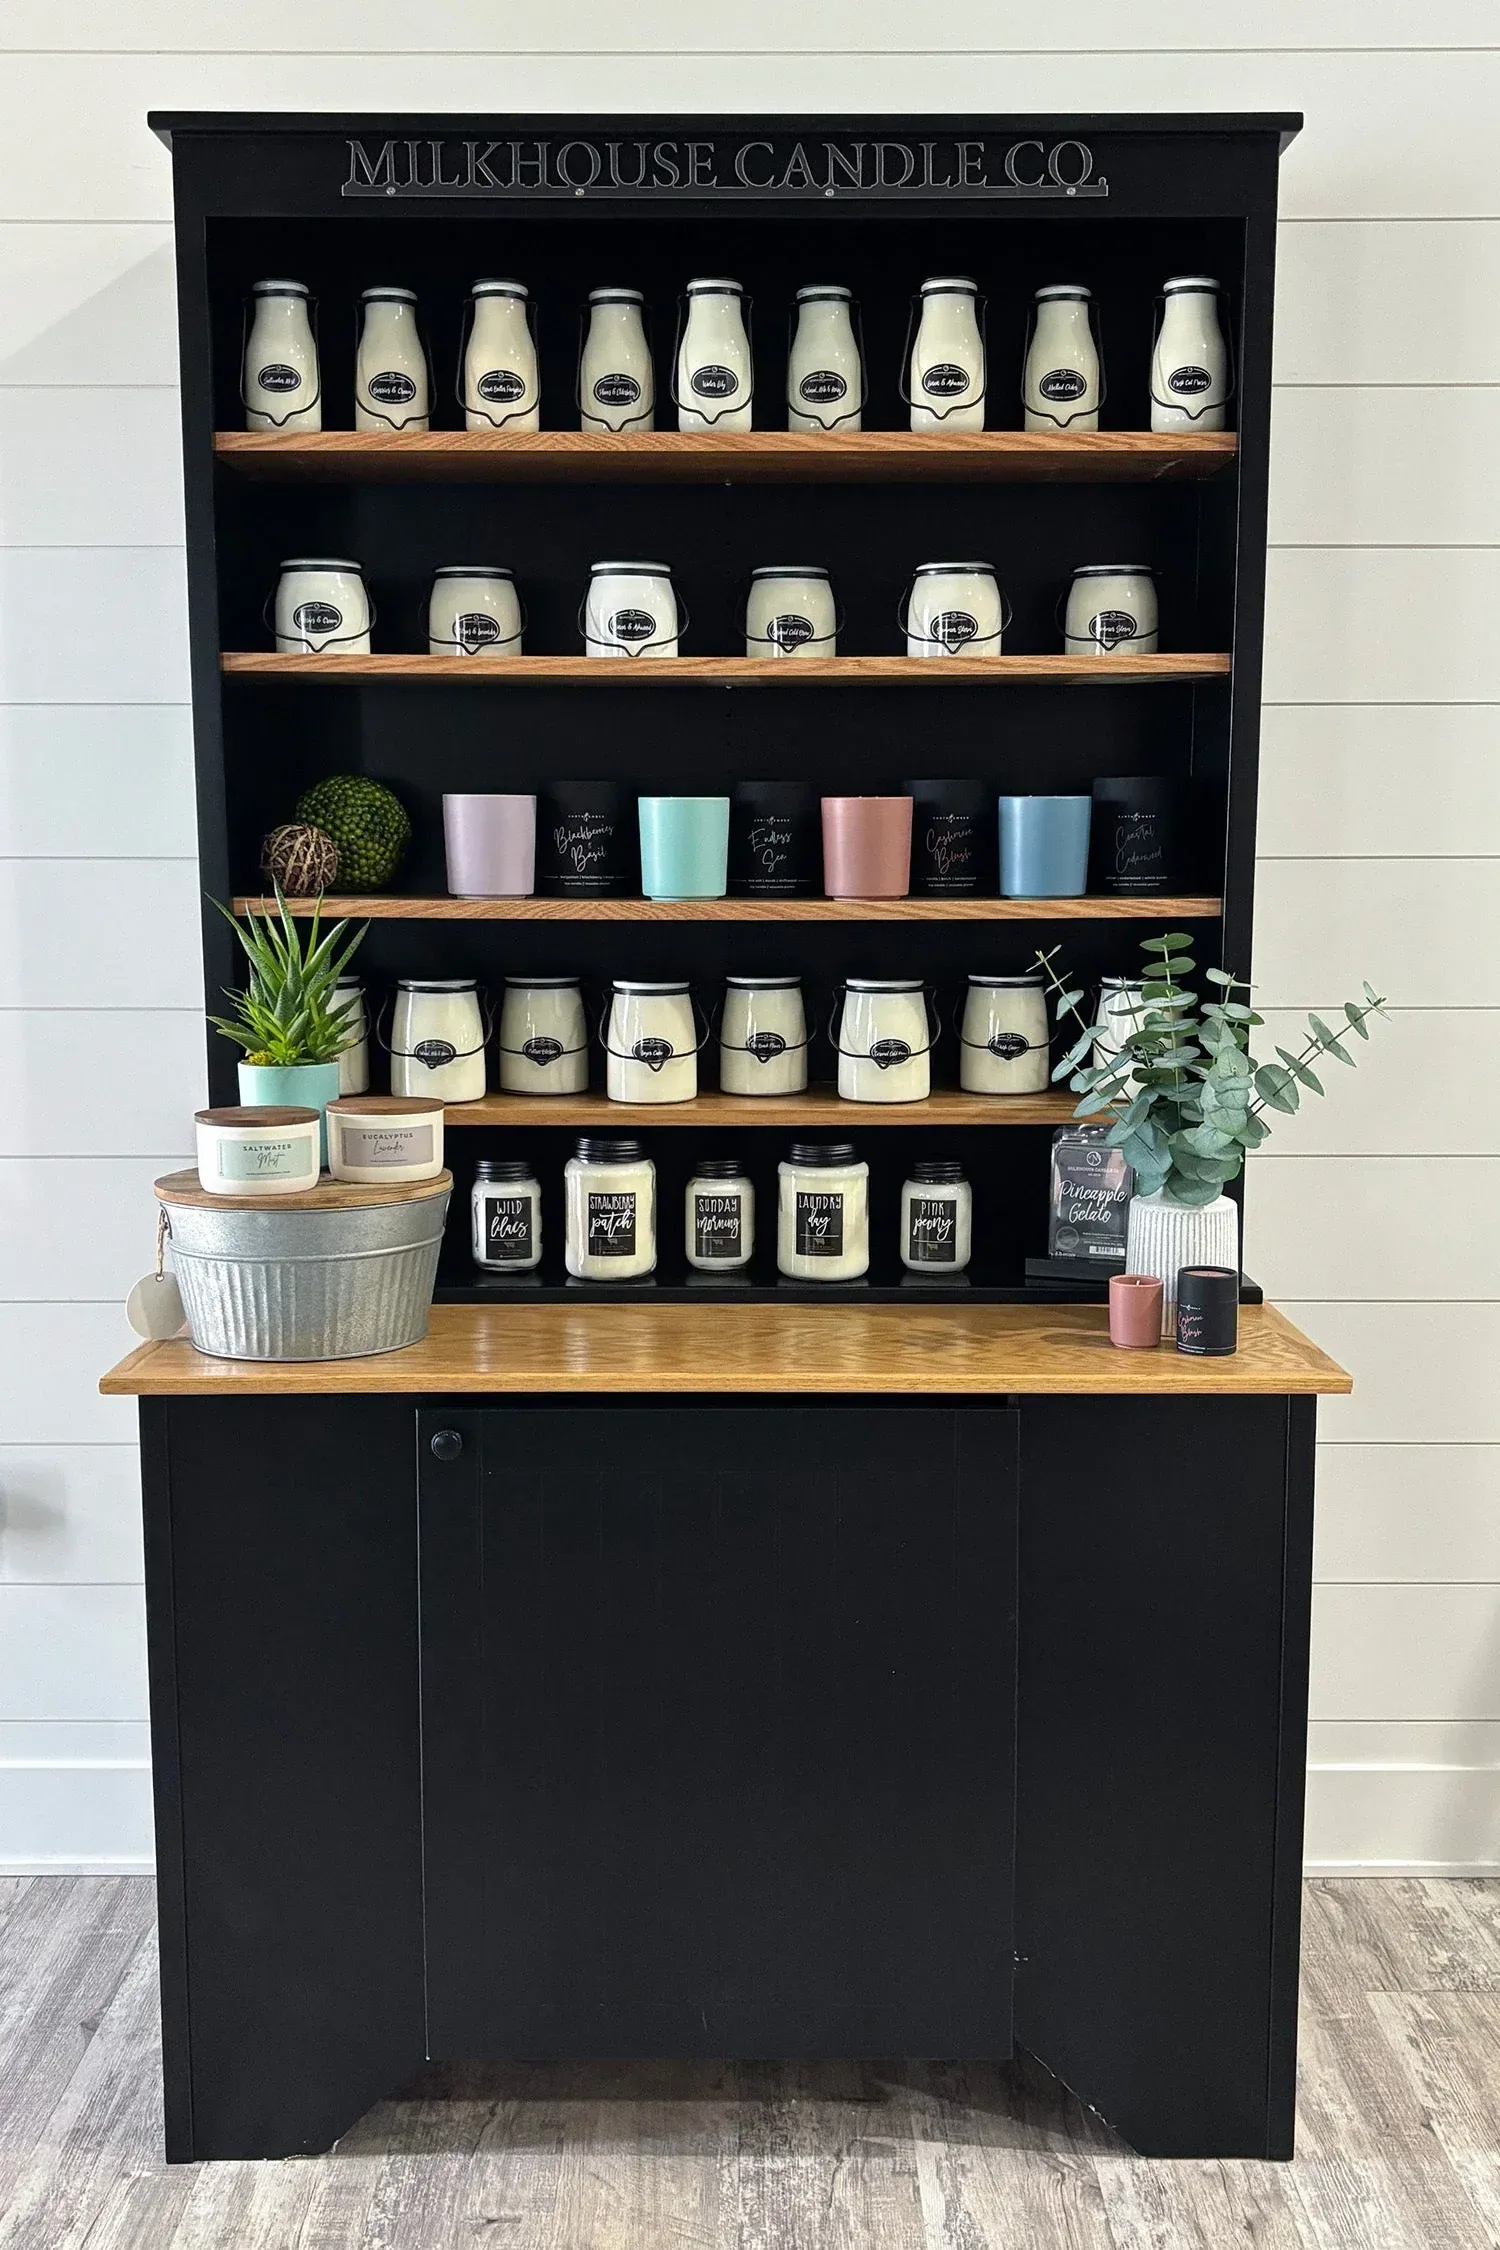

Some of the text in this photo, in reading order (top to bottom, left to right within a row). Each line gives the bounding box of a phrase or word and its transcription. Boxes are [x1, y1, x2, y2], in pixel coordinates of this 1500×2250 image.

[345, 140, 718, 189] MILKHOUSE
[734, 141, 988, 189] CANDLE
[570, 845, 607, 872] Basil
[362, 1132, 414, 1140] EUCALYPTUS
[243, 1143, 292, 1152] SALTWATER
[1059, 1179, 1128, 1207] Pineapple
[496, 1200, 522, 1215] WILD
[589, 1195, 635, 1210] STRAWBERRY
[698, 1198, 738, 1213] SUNDAY
[798, 1195, 842, 1210] LAUNDRY
[921, 1201, 945, 1216] PINK
[807, 1208, 832, 1236] day
[1068, 1202, 1112, 1224] Gelato
[589, 1209, 636, 1238] patch
[912, 1216, 954, 1241] peony
